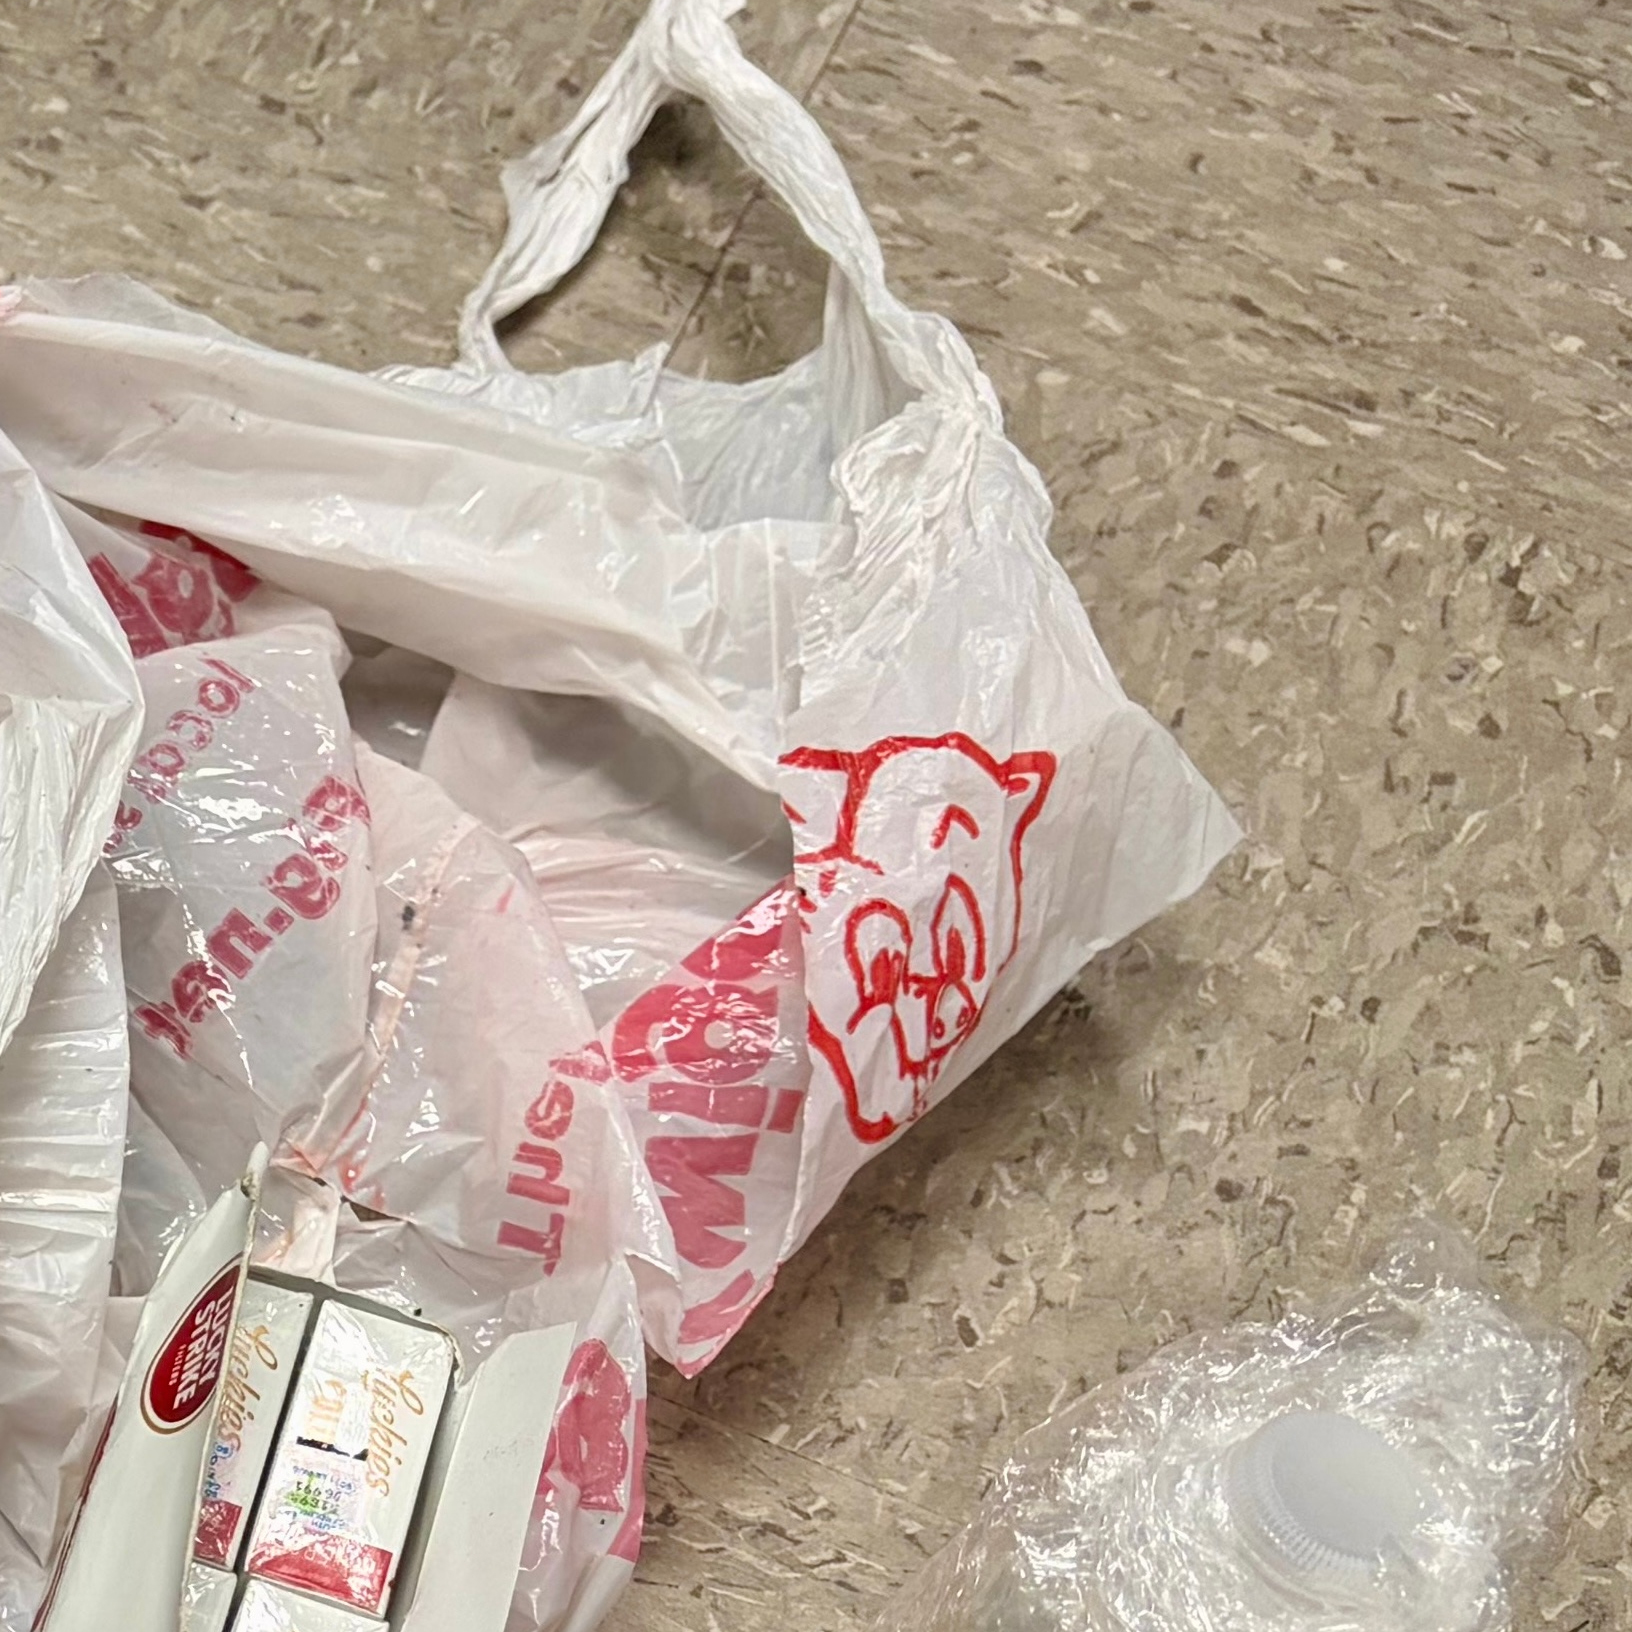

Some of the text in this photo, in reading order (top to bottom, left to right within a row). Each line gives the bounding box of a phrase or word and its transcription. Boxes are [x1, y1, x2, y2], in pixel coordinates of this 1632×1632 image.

[172, 1300, 214, 1409] STRIKE
[197, 1285, 233, 1386] LUCKY
[366, 1365, 426, 1499] Luckies
